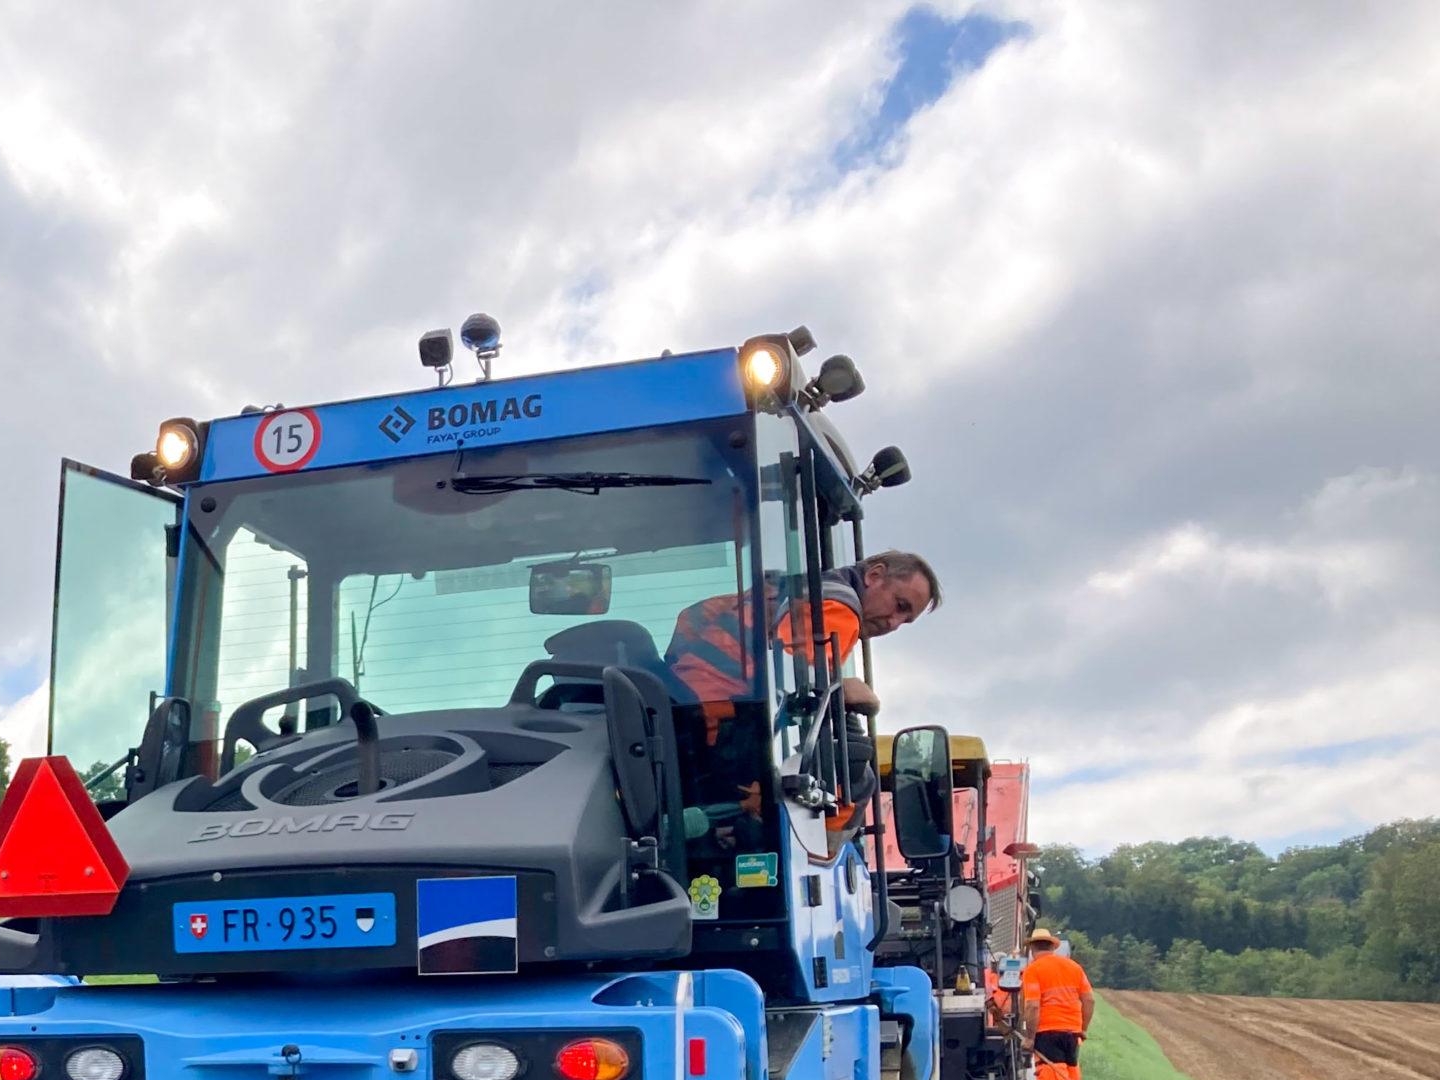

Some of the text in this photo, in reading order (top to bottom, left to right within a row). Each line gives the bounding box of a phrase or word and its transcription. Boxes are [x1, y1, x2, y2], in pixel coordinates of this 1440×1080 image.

[427, 394, 543, 431] BOMAG
[271, 423, 303, 455] 15
[426, 427, 502, 445] FAYAT GROUP
[186, 812, 417, 844] BOMAG
